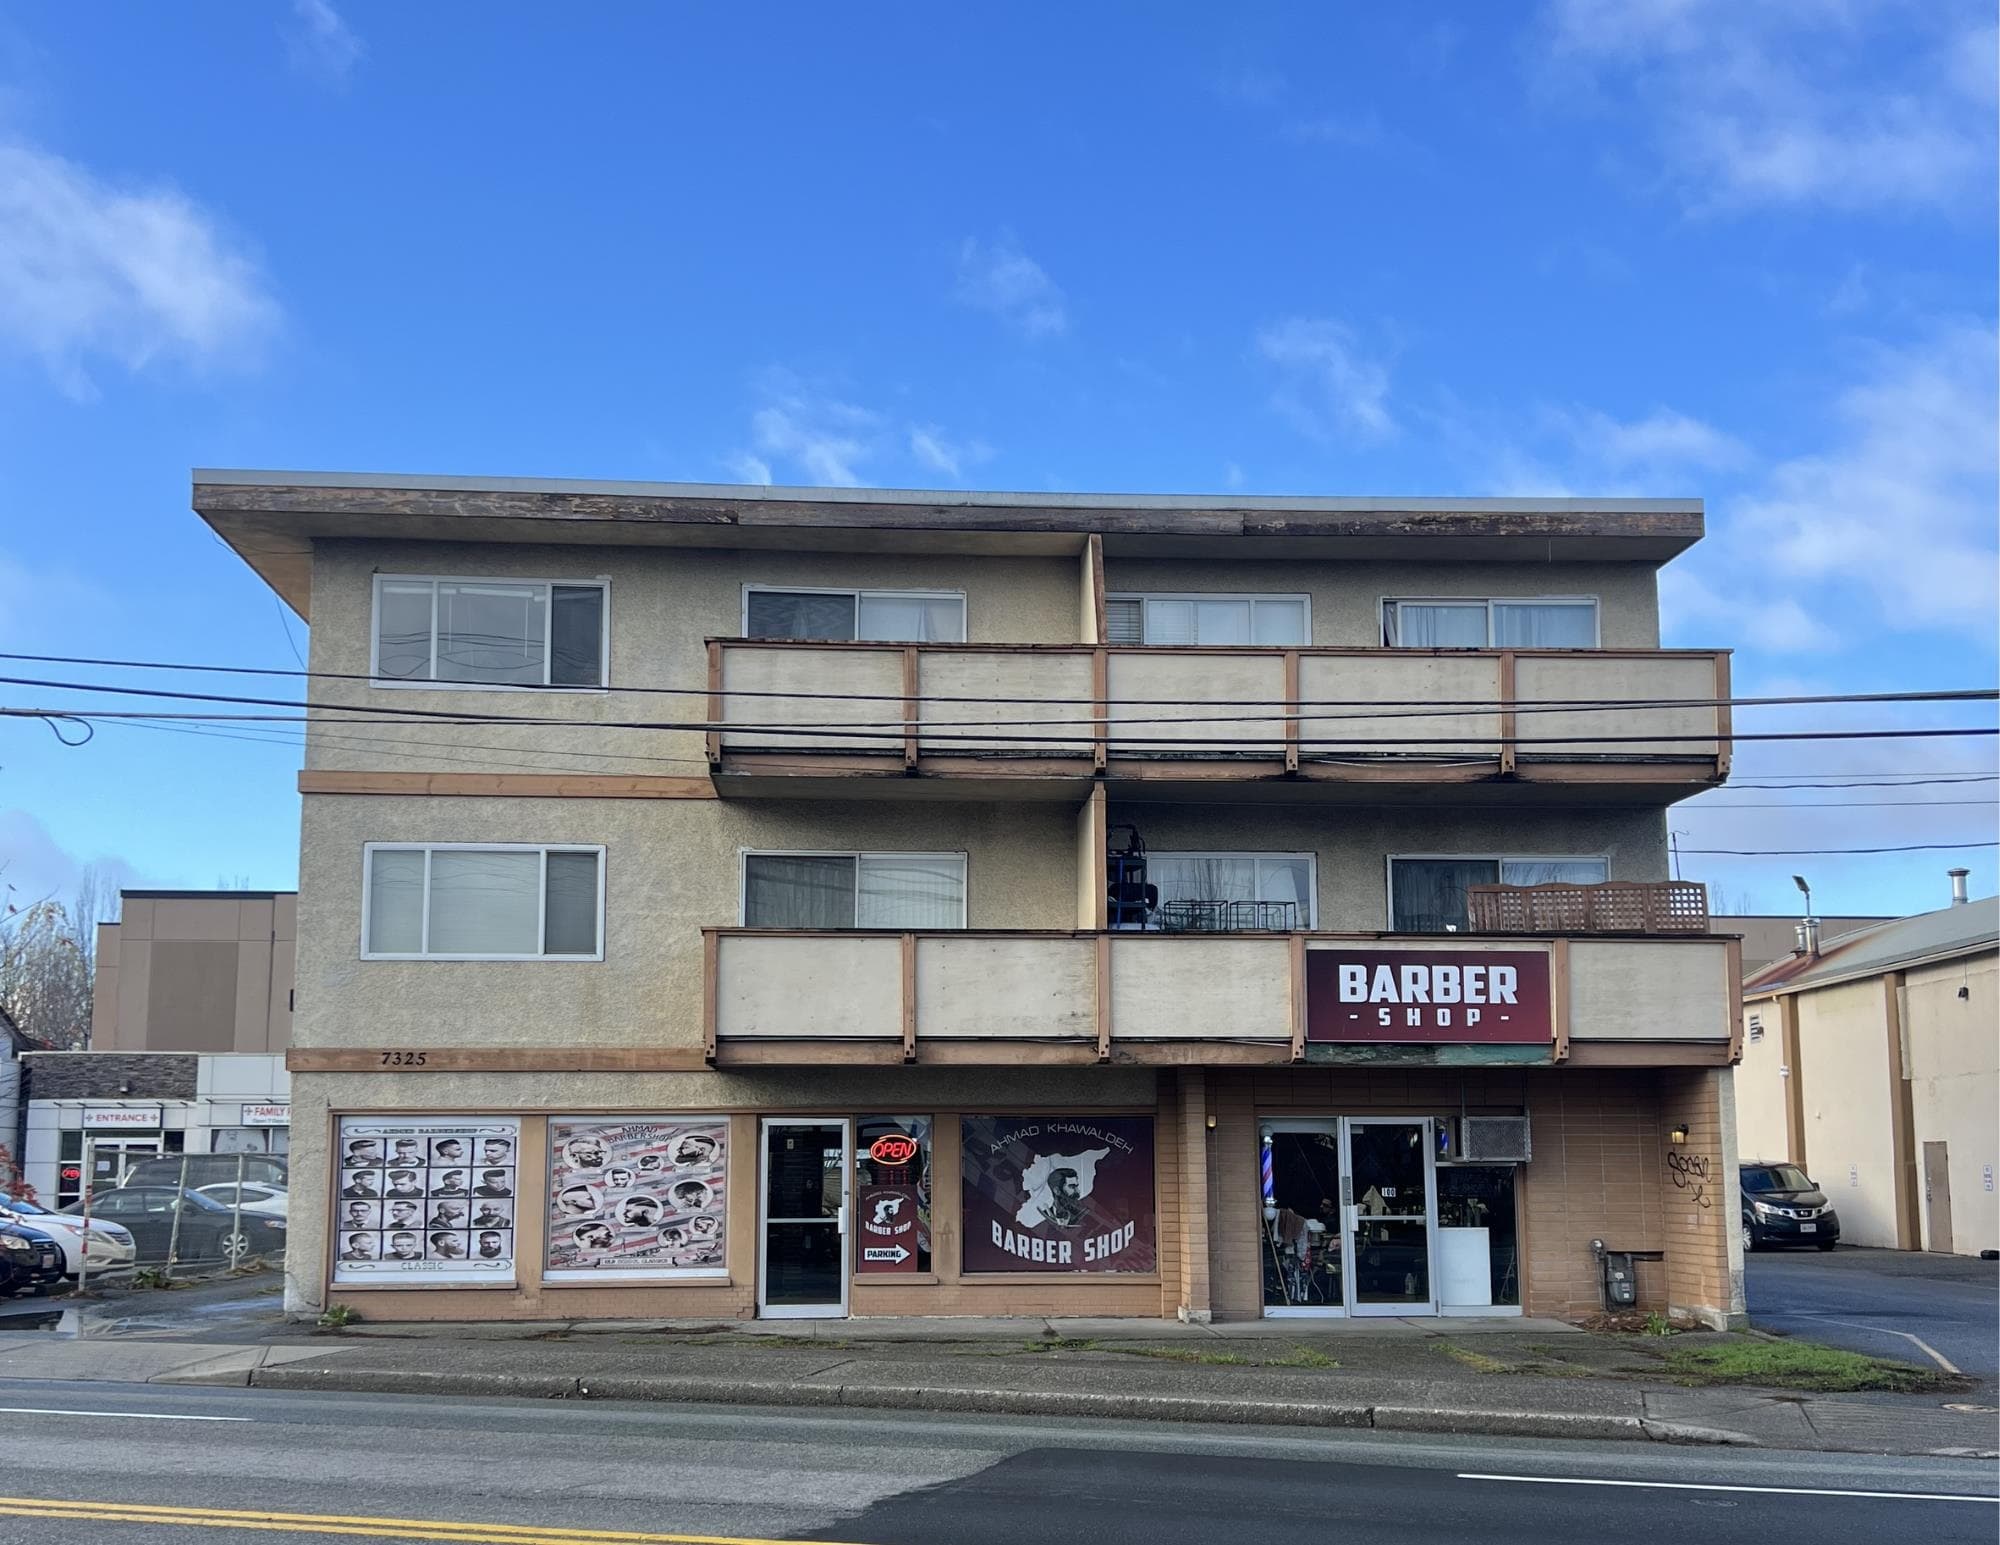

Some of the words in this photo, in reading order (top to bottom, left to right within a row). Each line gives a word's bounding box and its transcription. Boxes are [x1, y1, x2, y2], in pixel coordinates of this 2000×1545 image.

[1338, 964, 1518, 1004] BARBER
[382, 1052, 427, 1066] 7325
[95, 1113, 148, 1122] ENTRANCE
[255, 1106, 286, 1116] FAMILY
[622, 1125, 658, 1134] AHMAD
[607, 1132, 673, 1144] BARBERSHOP
[990, 1125, 1040, 1154] AHMAD
[1047, 1123, 1135, 1154] KHAWALDEH
[872, 1142, 913, 1158] OPEN
[865, 1221, 891, 1235] BARBER
[894, 1220, 912, 1235] SHOP
[991, 1219, 1072, 1264] BARBER
[1084, 1220, 1135, 1262] SHOP
[866, 1250, 902, 1258] PARKING
[401, 1262, 444, 1271] CLASSIC
